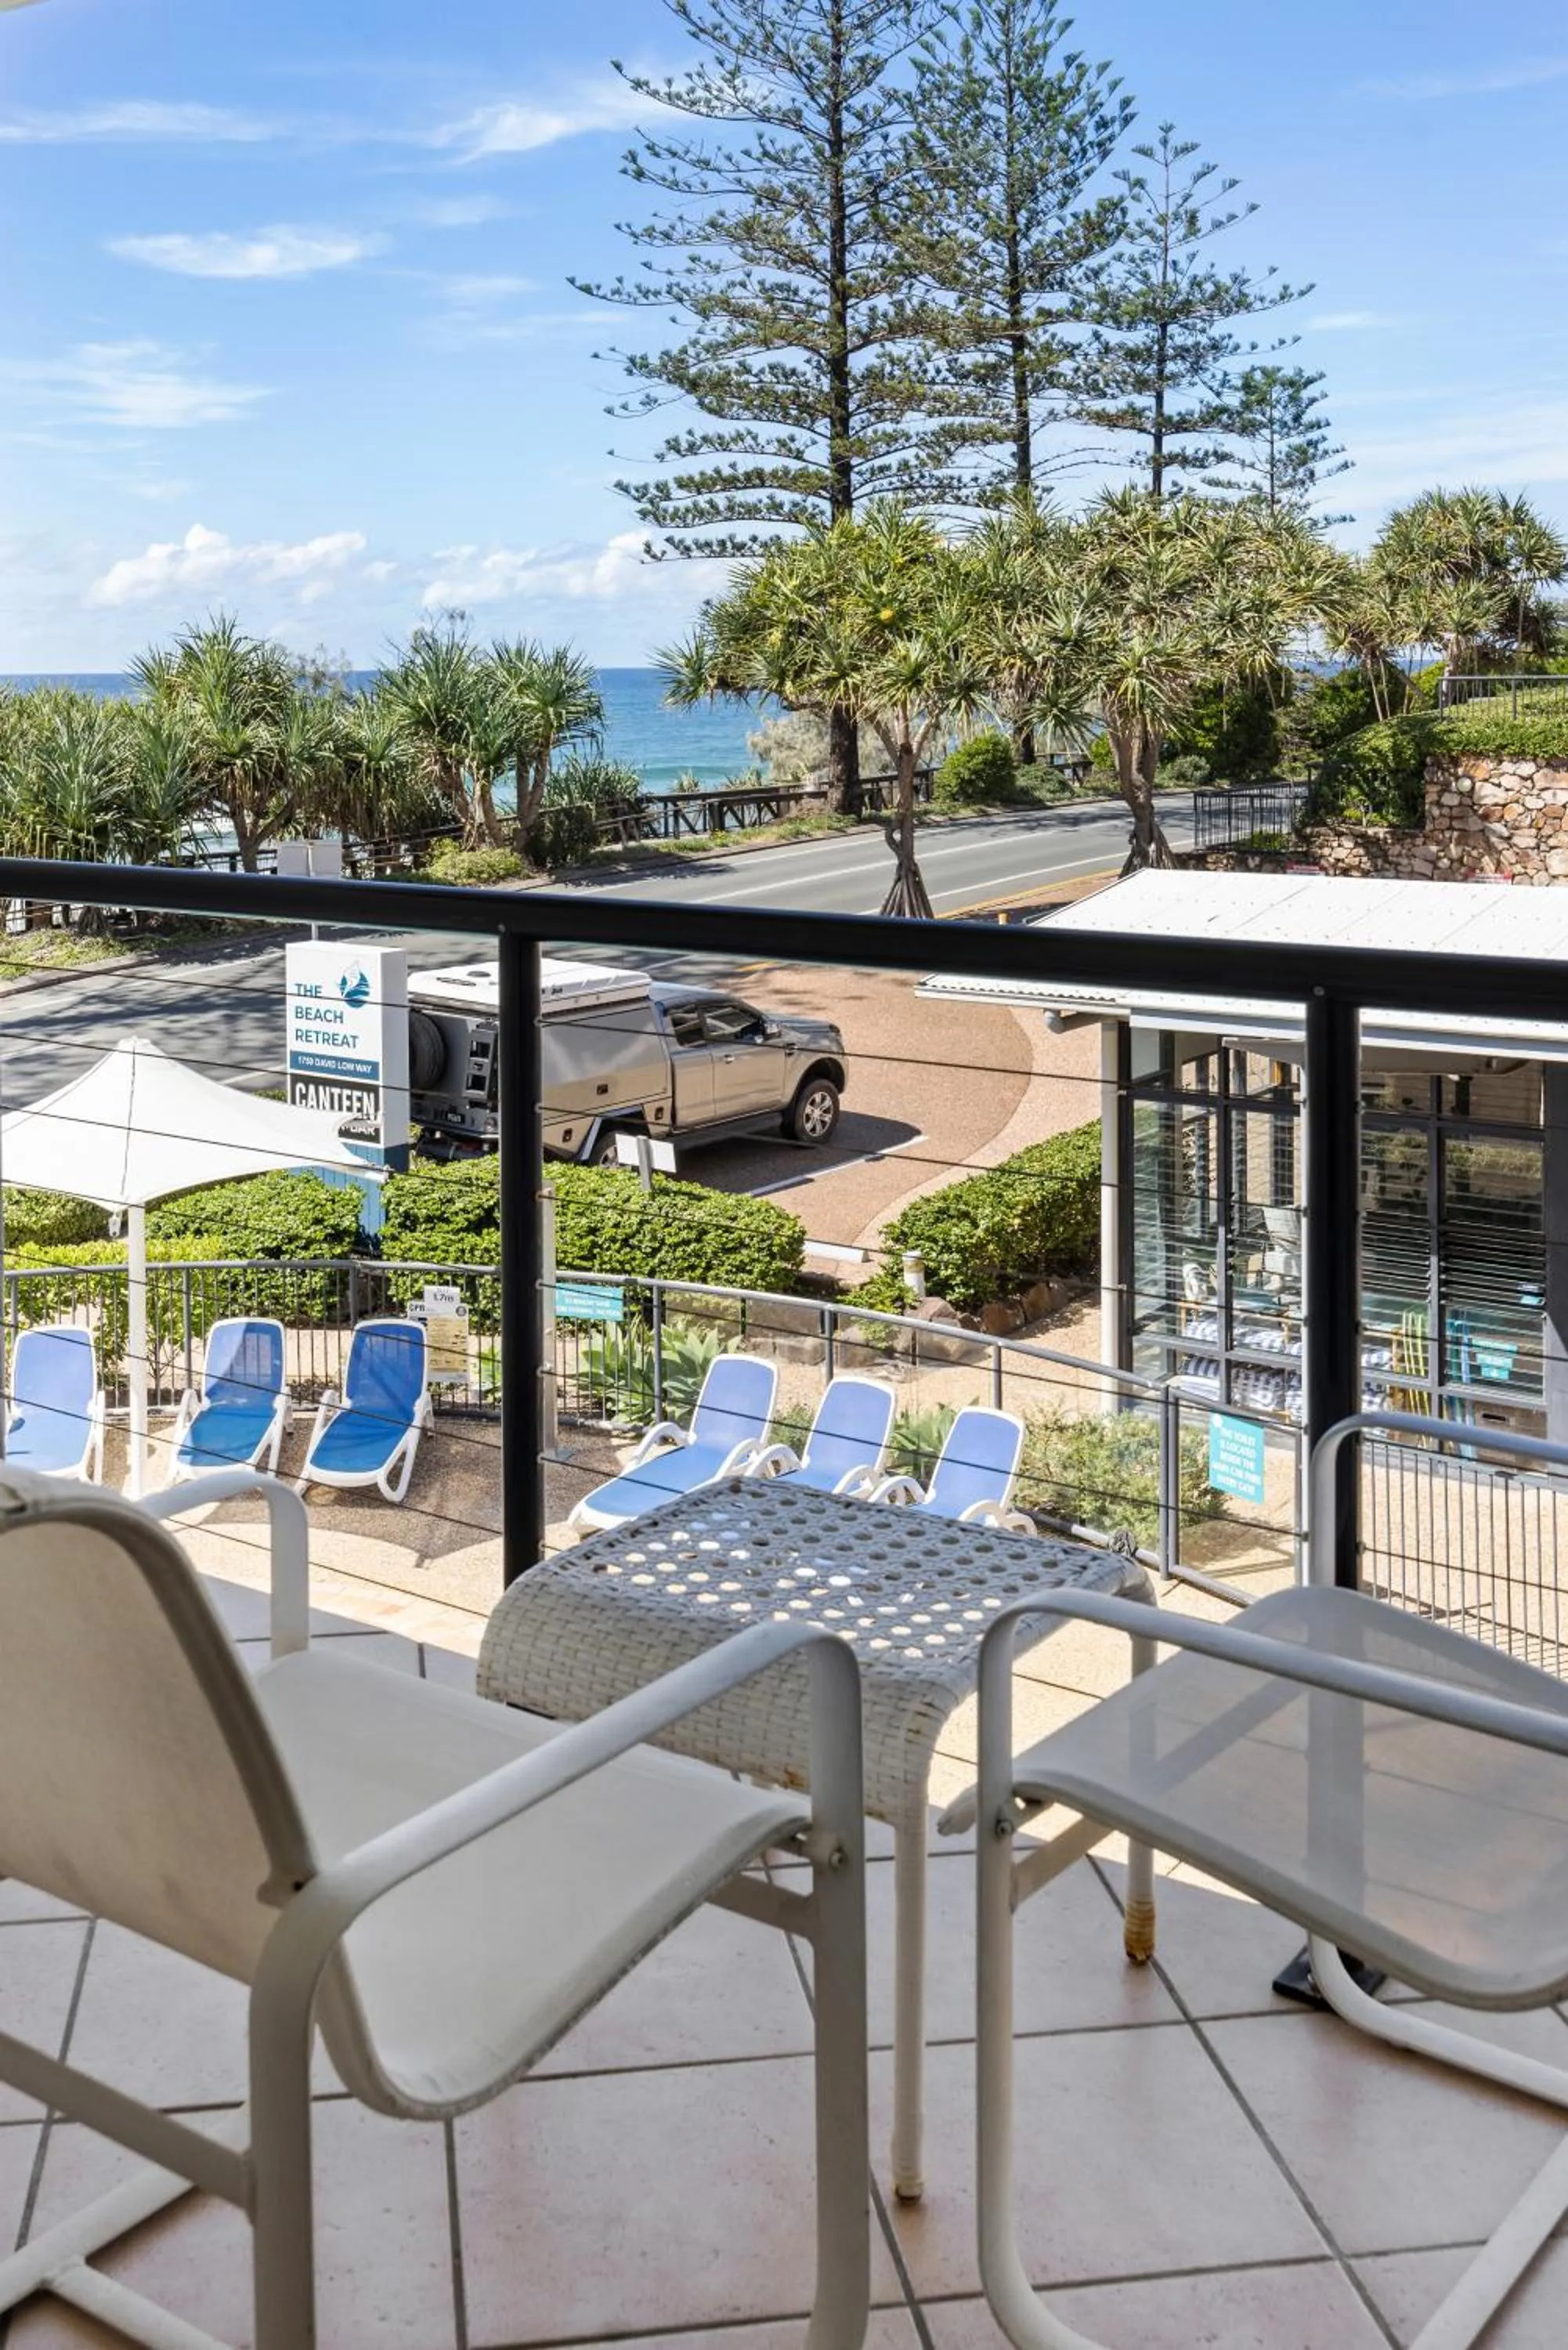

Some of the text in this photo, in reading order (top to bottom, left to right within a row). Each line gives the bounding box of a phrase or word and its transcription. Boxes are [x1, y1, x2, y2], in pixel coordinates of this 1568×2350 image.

[294, 983, 322, 999] THE
[294, 1005, 344, 1024] BEACH
[295, 1028, 359, 1048] RETREAT
[356, 1063, 372, 1074] WAY
[294, 1082, 376, 1122] CANTEEN
